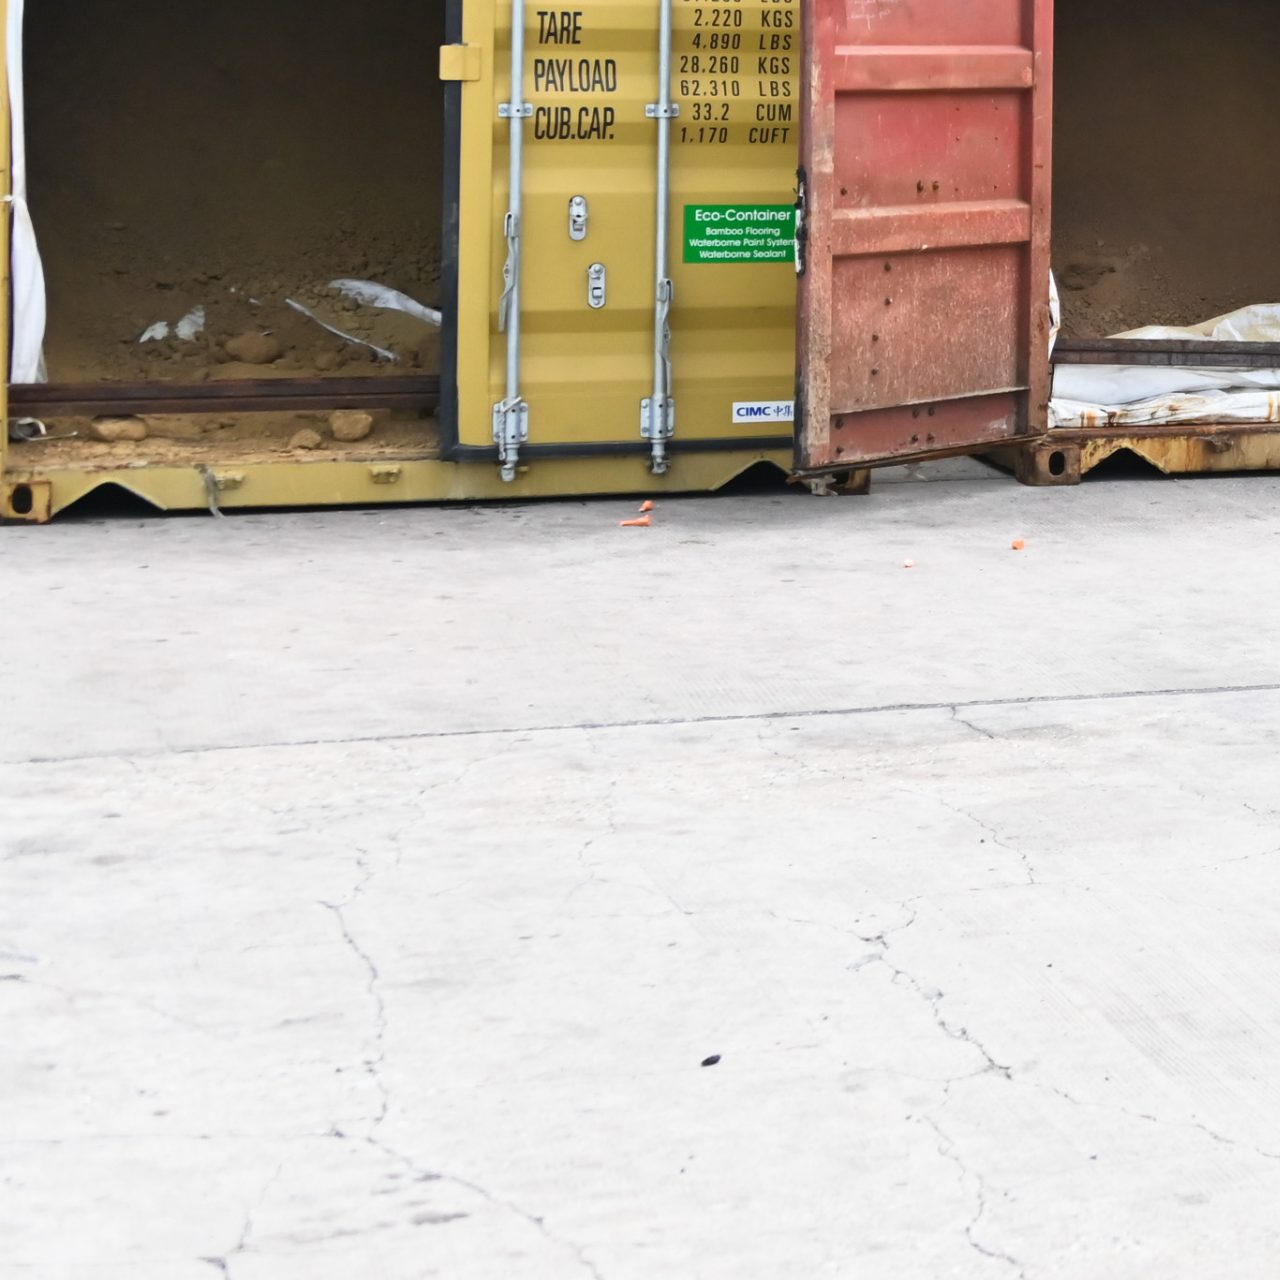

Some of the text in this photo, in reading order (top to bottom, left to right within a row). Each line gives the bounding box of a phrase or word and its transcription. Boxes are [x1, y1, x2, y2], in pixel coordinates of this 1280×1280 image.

[537, 10, 794, 45] TARE KGS
[759, 34, 792, 51] LBS
[534, 57, 791, 93] PAYLOAD KGS
[758, 81, 791, 97] LBS
[534, 102, 792, 140] CUB.CAP. 33.2 CUM
[749, 128, 790, 144] CUFT
[695, 209, 791, 222] Eco-Container
[705, 226, 781, 237] Bamboo Flooring
[689, 238, 741, 247] Waterborne
[743, 238, 765, 246] Paint
[699, 249, 787, 259] Waterborne Sealant
[736, 406, 771, 417] CIMC
